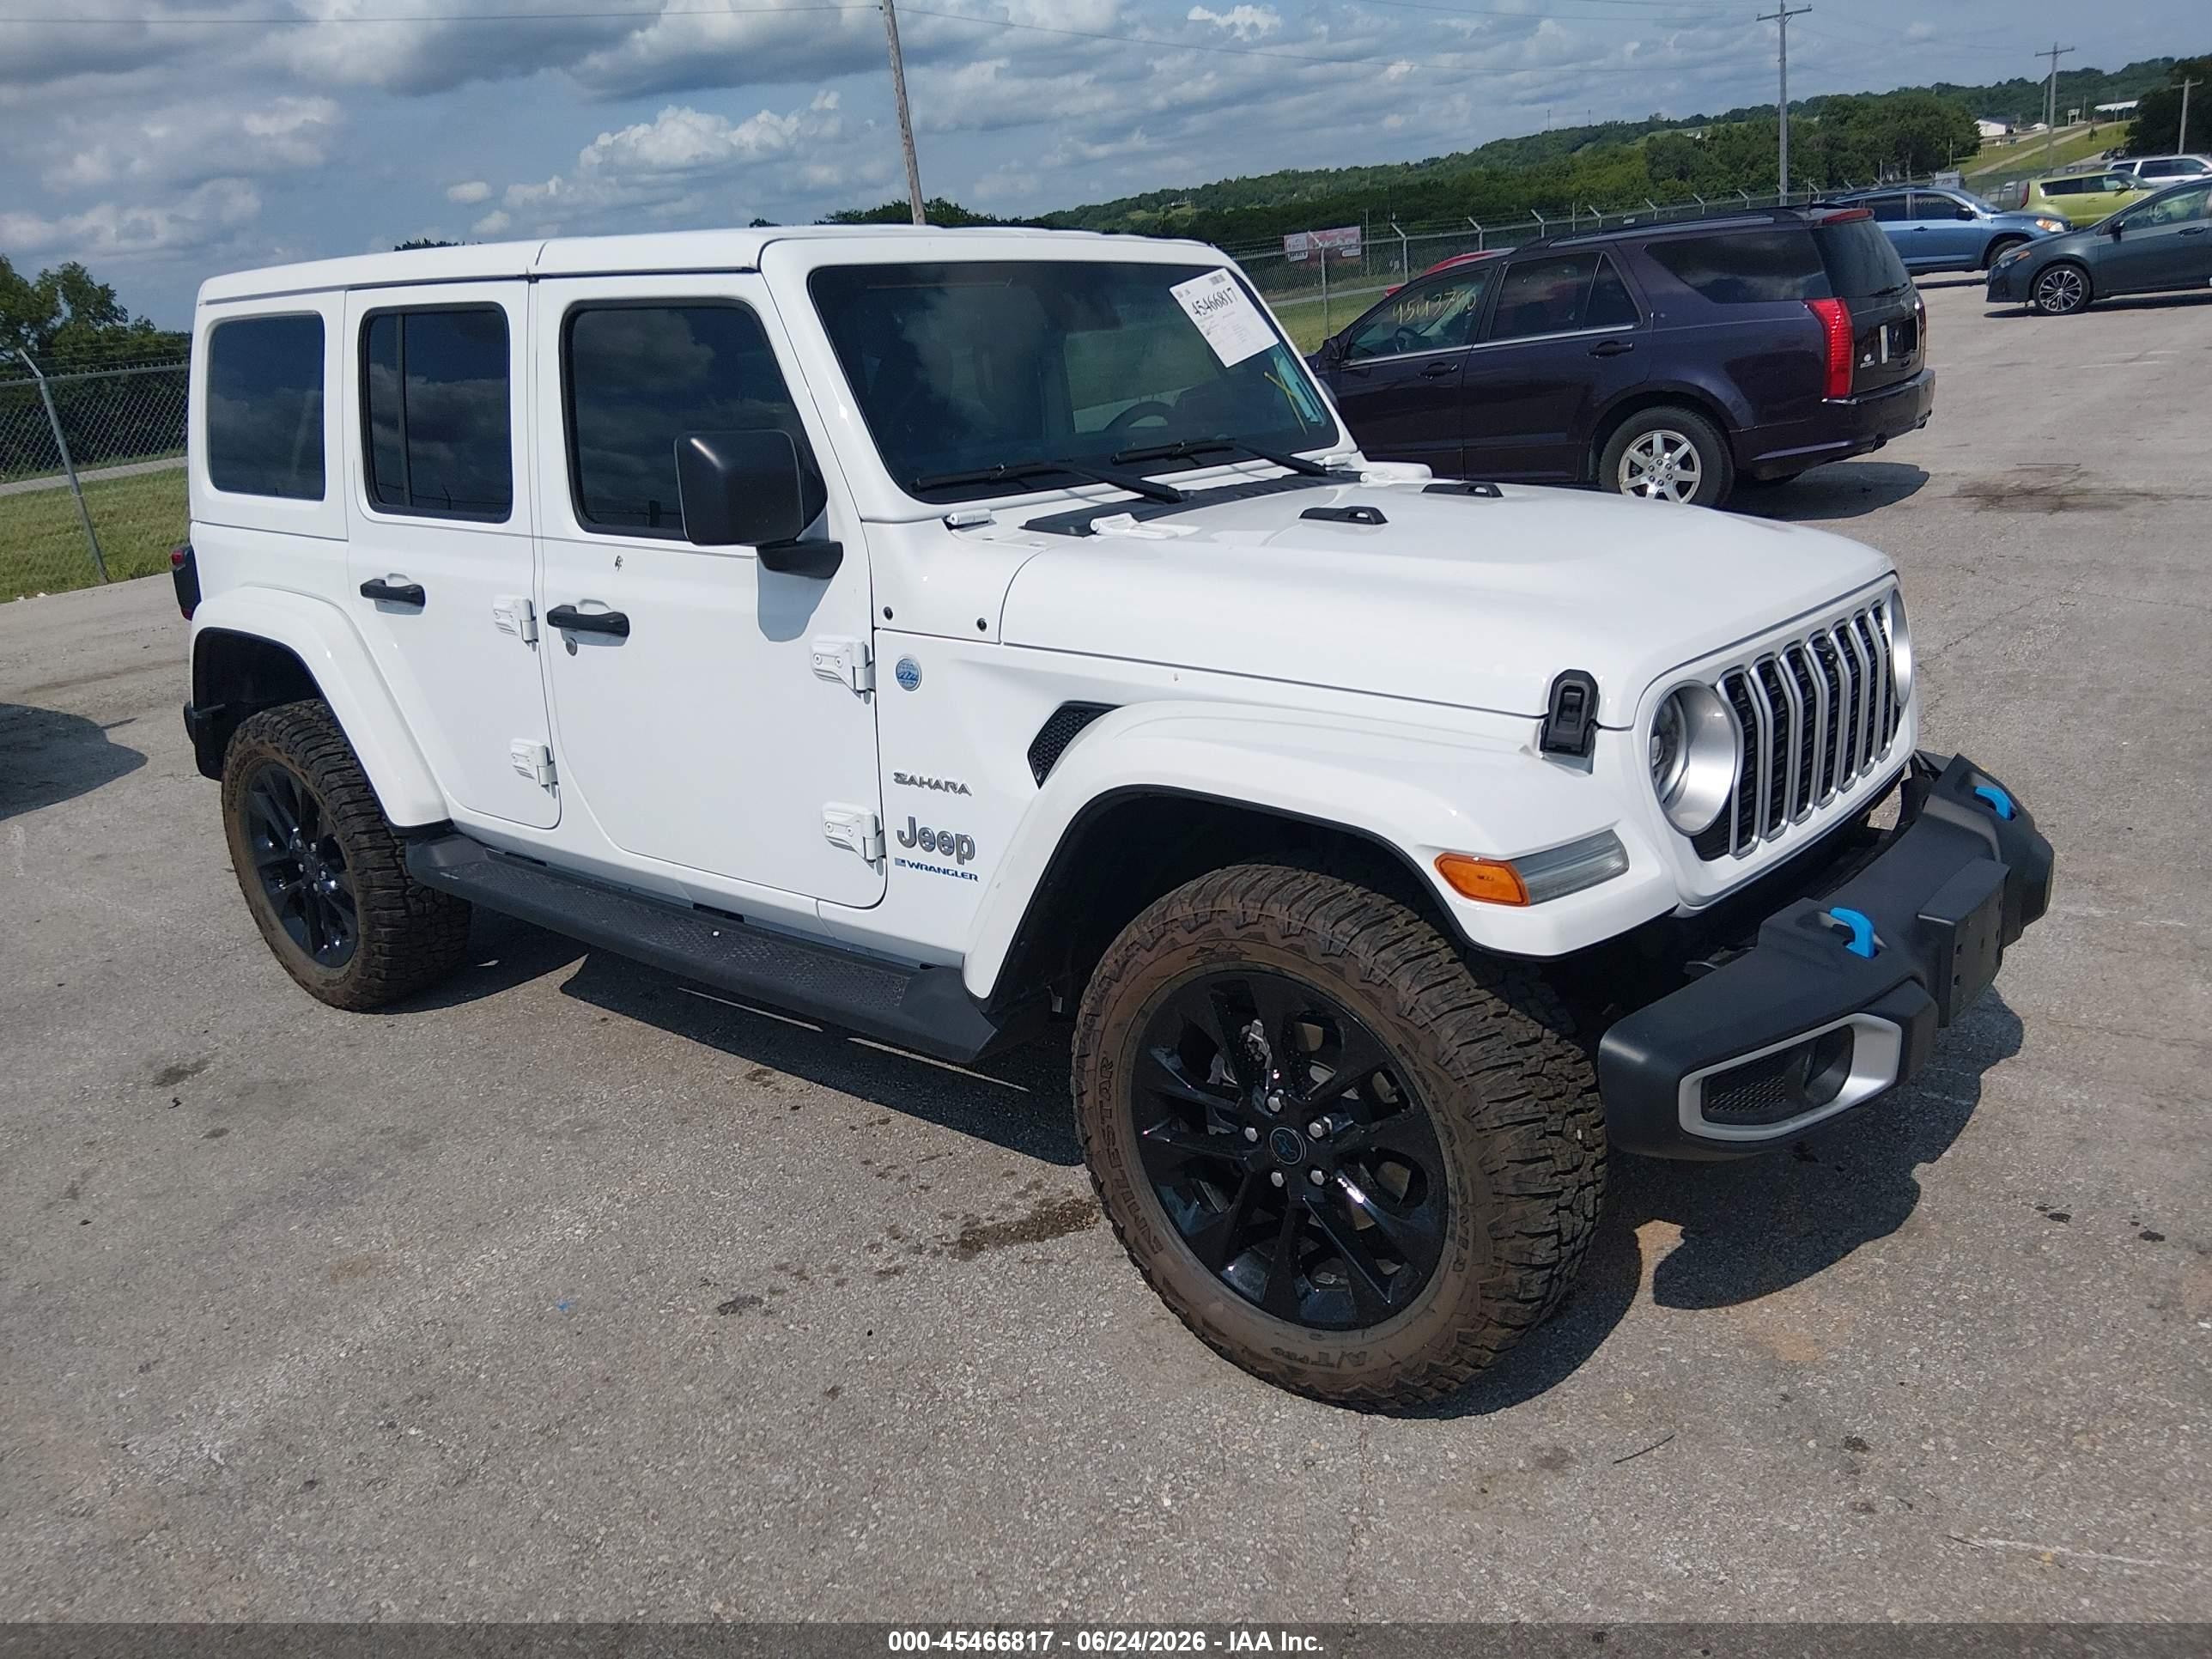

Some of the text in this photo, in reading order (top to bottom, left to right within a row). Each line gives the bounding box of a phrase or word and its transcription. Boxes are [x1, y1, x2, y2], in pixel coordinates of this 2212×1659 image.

[1191, 287, 1238, 317] 45466817
[893, 772, 972, 797] SAHARA
[896, 816, 975, 866] Jeep
[907, 860, 979, 883] WRANGLER
